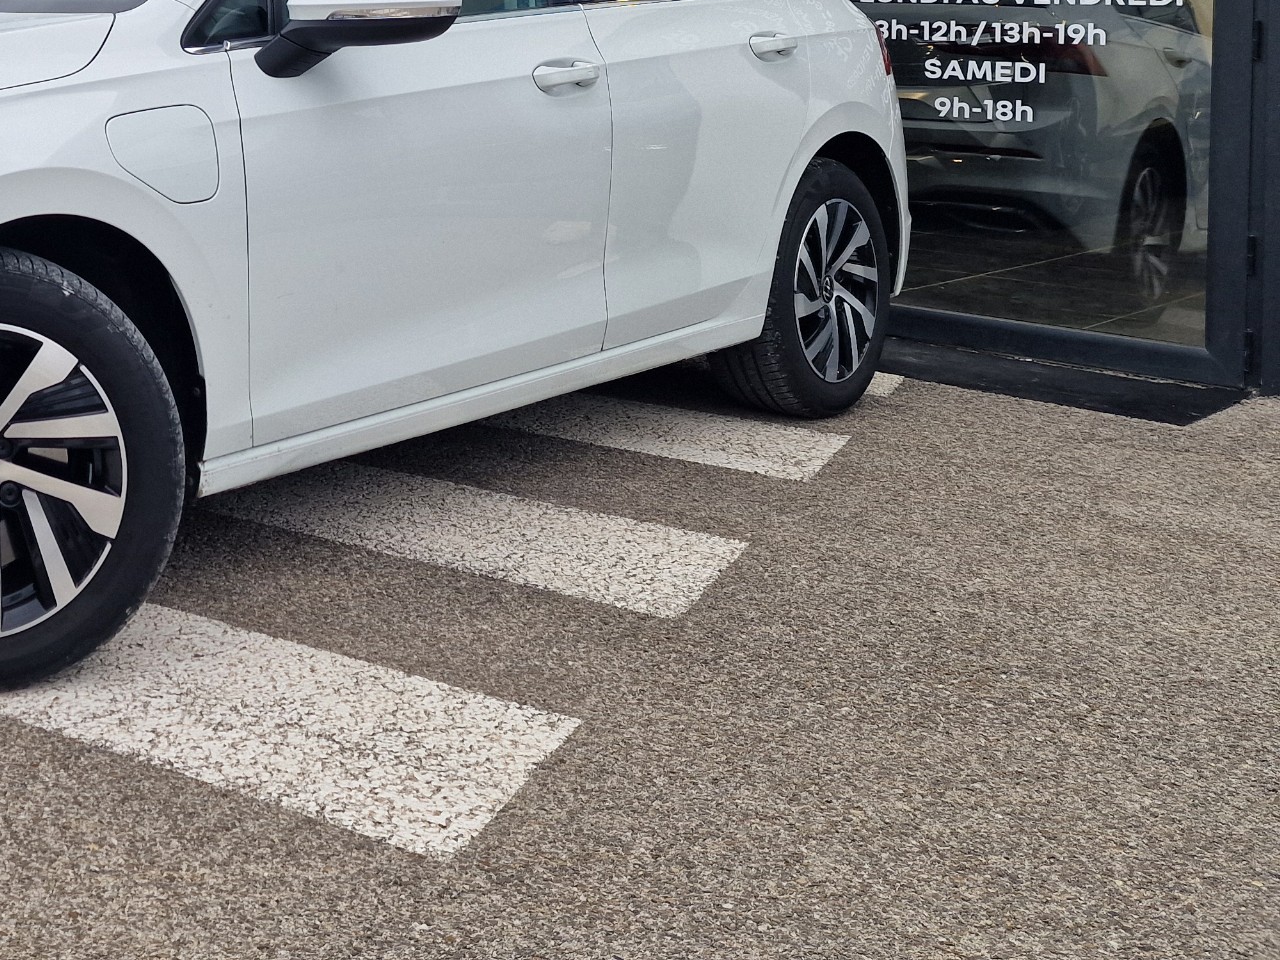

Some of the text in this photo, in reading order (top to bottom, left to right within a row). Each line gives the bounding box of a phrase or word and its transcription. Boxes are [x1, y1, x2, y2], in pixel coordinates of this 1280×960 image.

[991, 21, 1107, 46] 13h-19h
[924, 59, 1046, 84] SAMEDI
[934, 96, 1034, 123] 9h-18h
